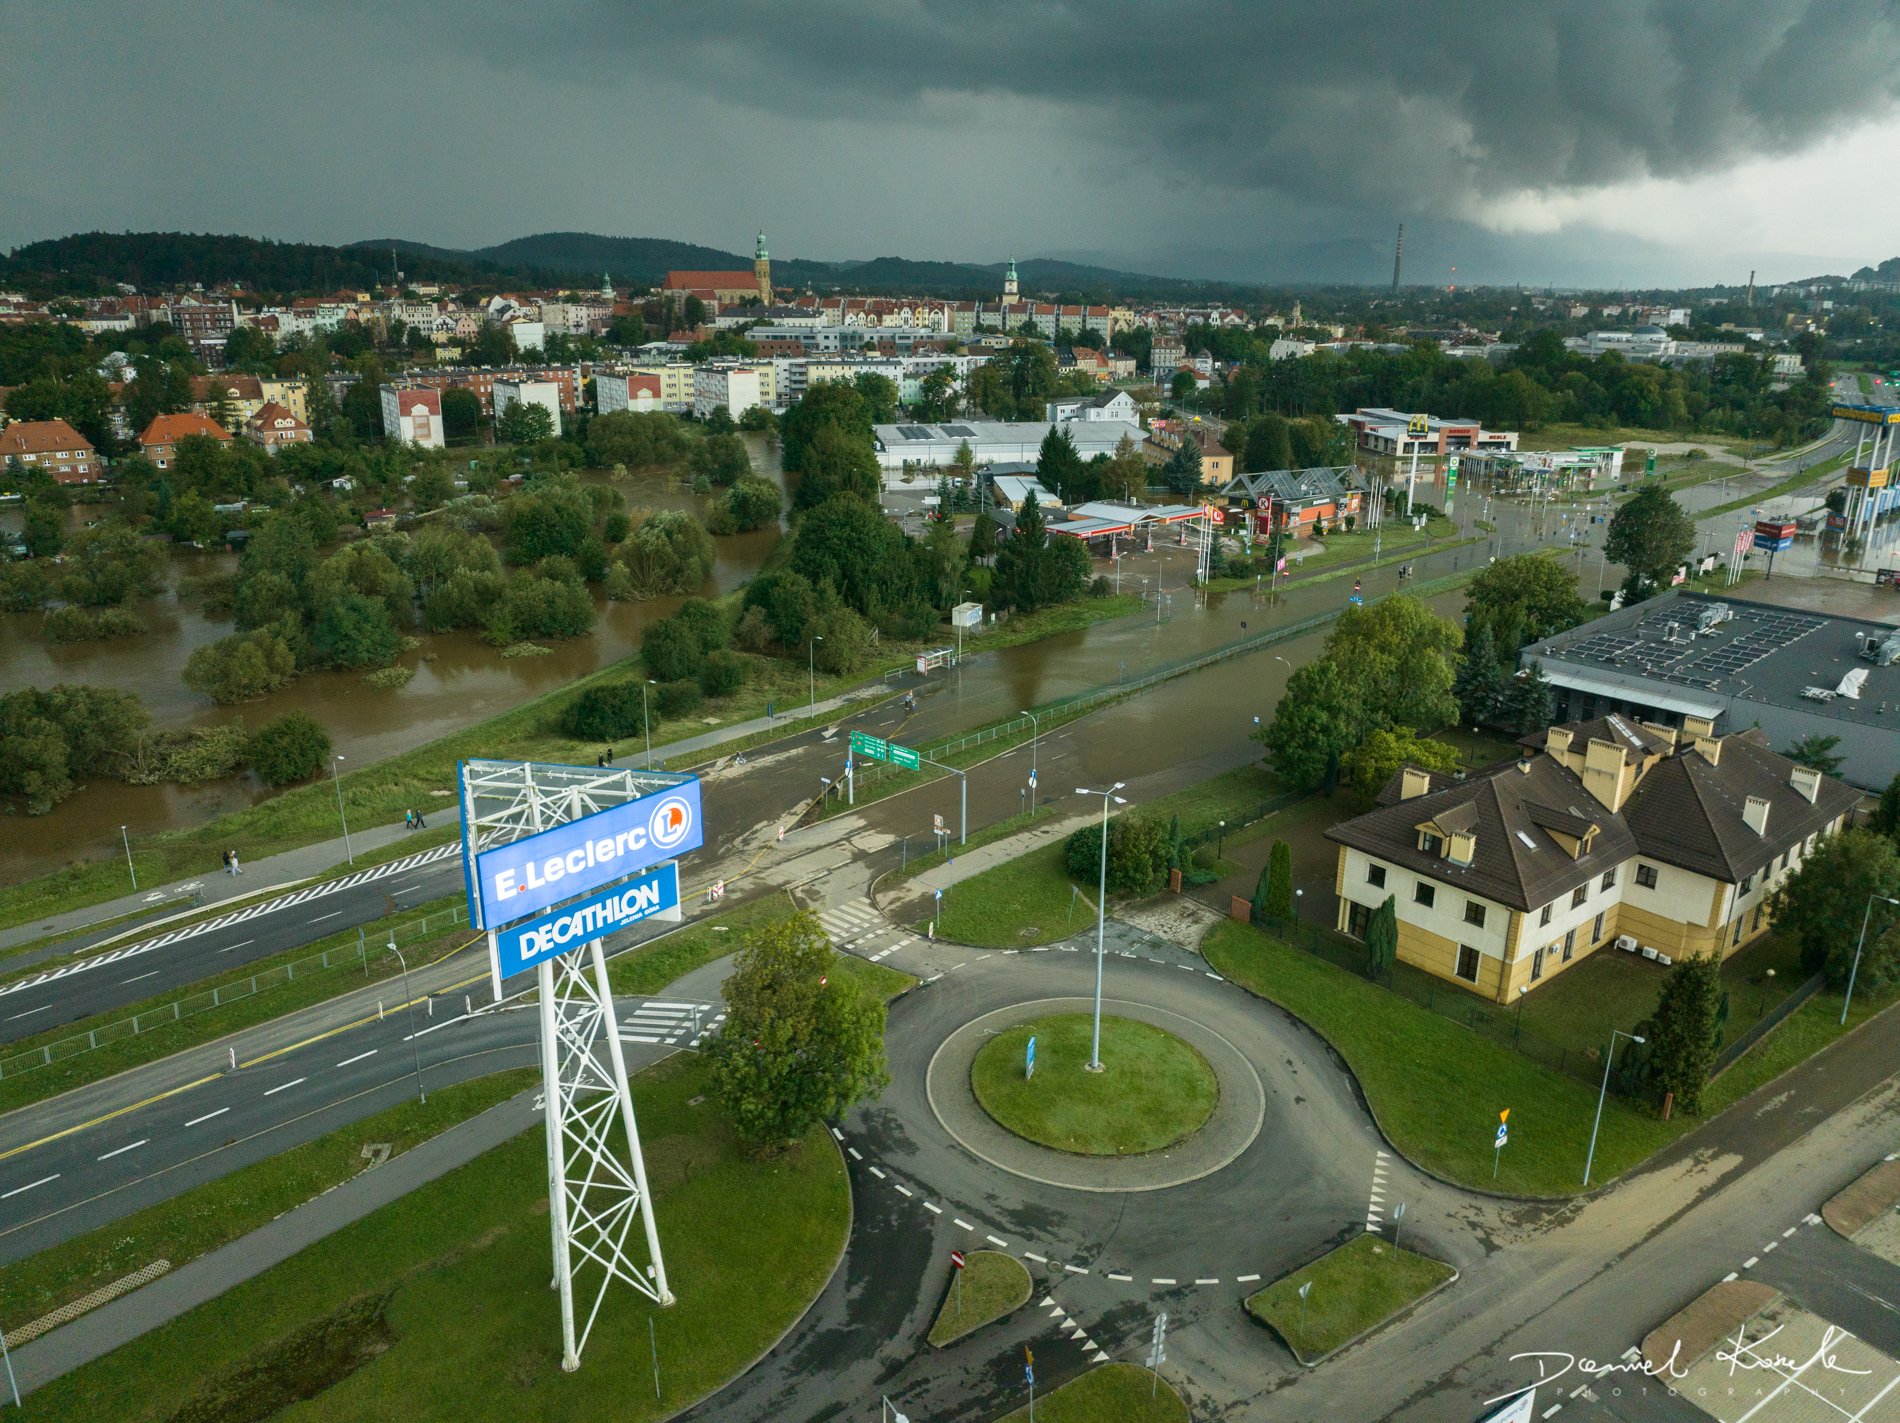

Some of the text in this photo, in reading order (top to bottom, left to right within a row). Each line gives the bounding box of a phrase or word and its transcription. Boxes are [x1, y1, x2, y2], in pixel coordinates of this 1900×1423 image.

[495, 827, 647, 901] E.Leclerc
[519, 880, 660, 960] DECATHLON
[620, 912, 643, 925] JELENIA
